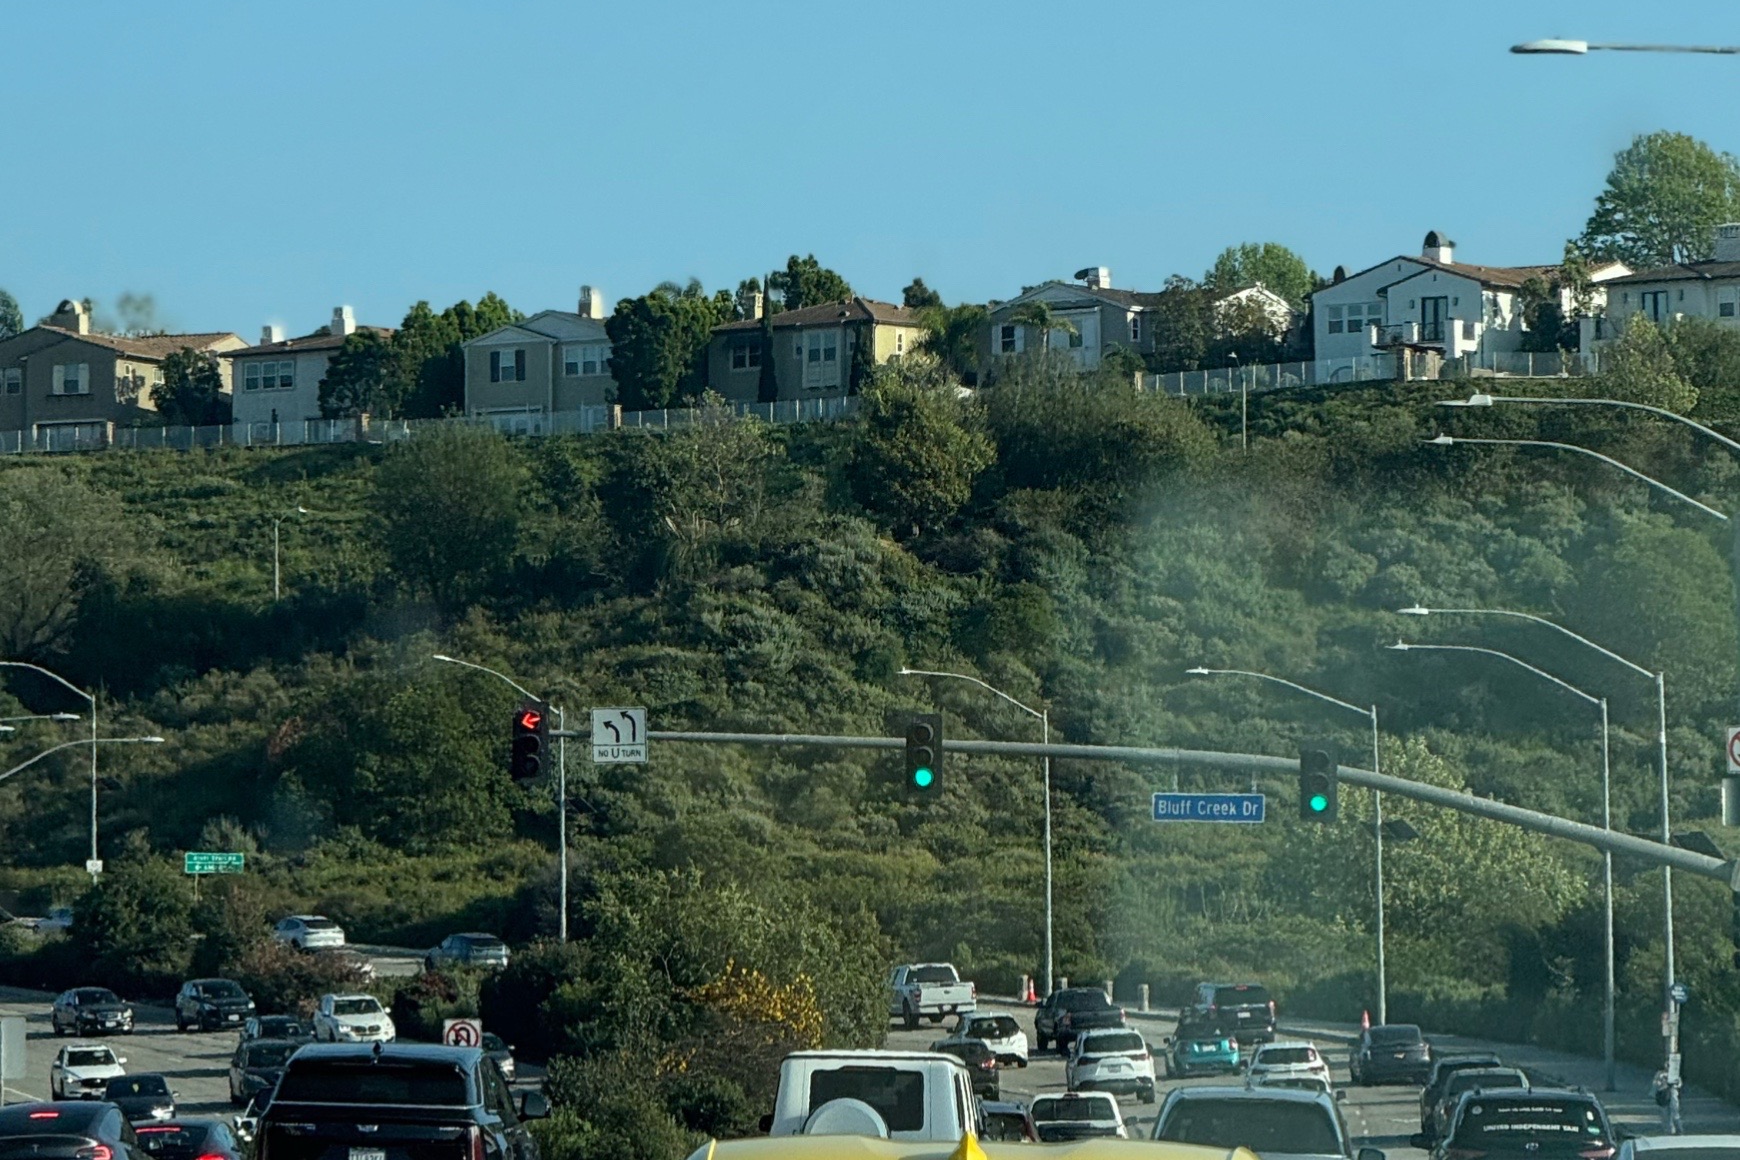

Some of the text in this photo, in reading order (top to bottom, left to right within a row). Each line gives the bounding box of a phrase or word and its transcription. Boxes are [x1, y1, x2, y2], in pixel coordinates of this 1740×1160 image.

[612, 748, 619, 759] U
[1158, 800, 1259, 816] Bluff Creek Dr
